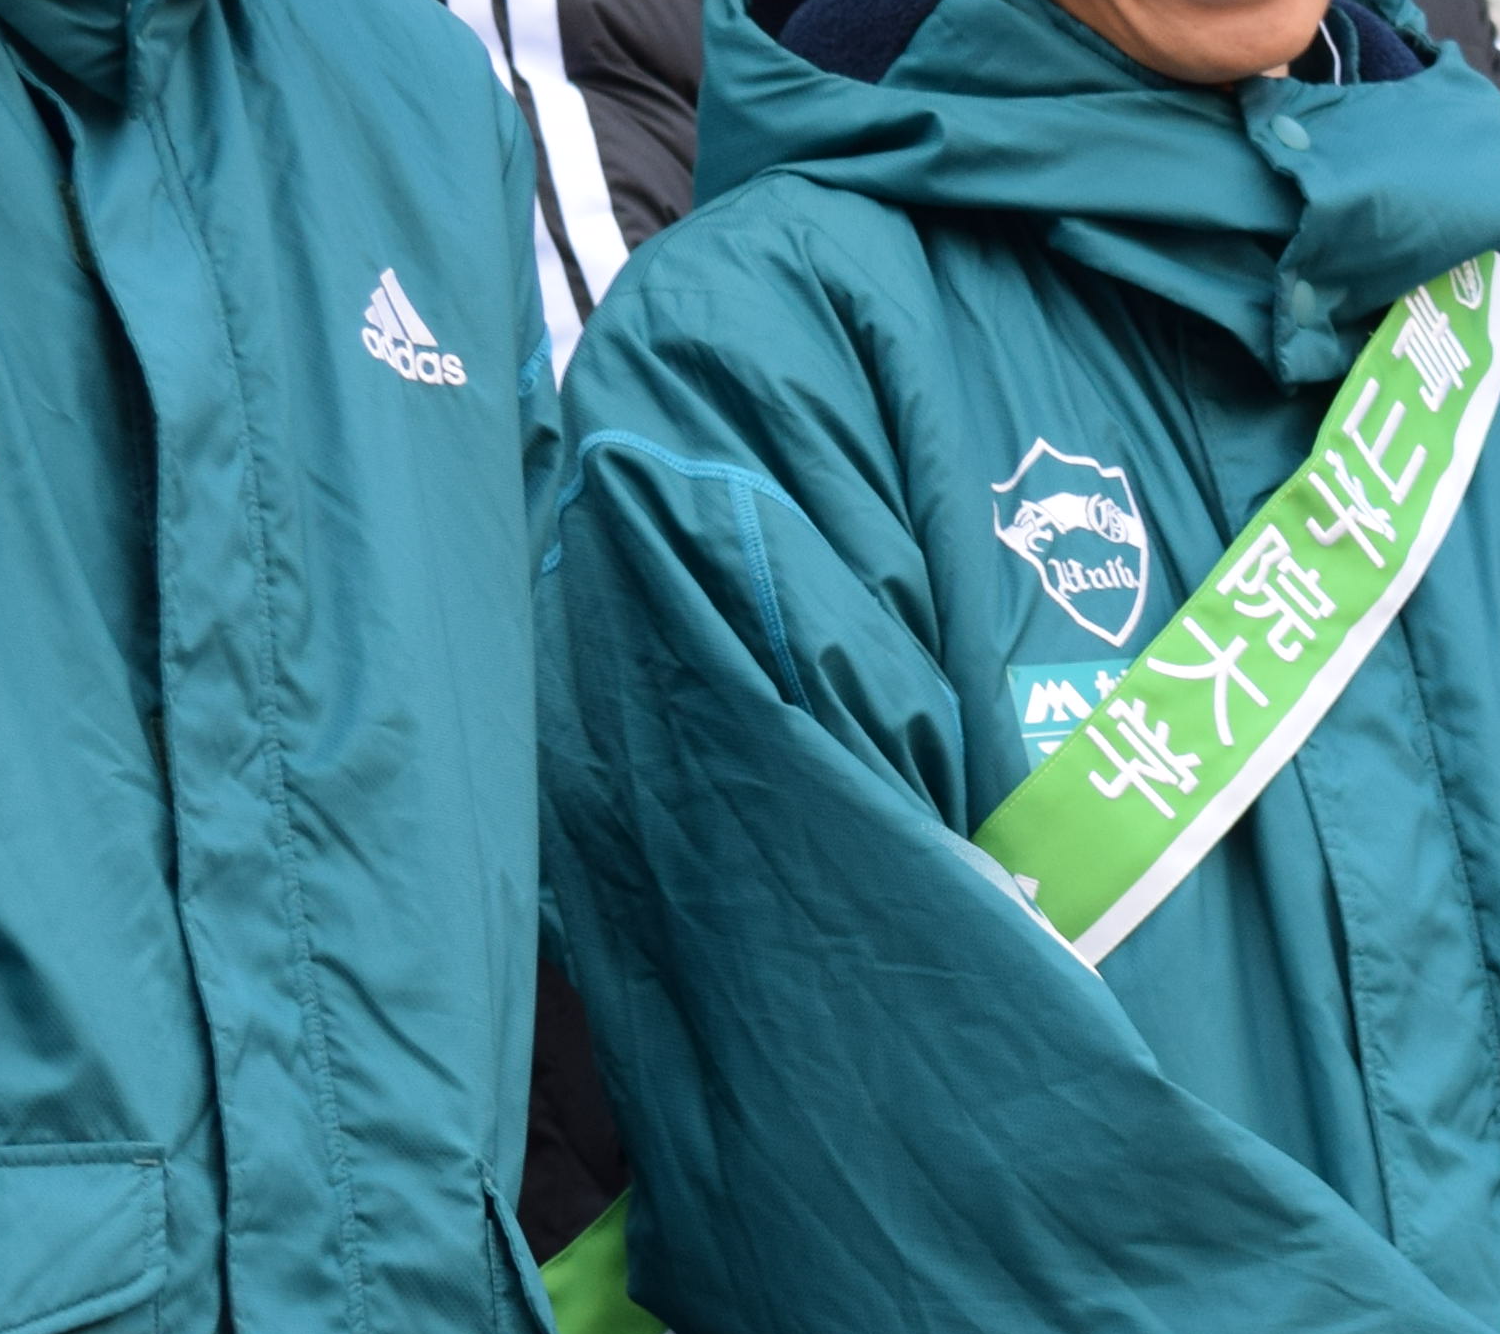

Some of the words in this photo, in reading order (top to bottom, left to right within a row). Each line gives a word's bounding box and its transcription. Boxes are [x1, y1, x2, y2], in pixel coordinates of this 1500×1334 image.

[1085, 284, 1473, 820] 青山学院大学
